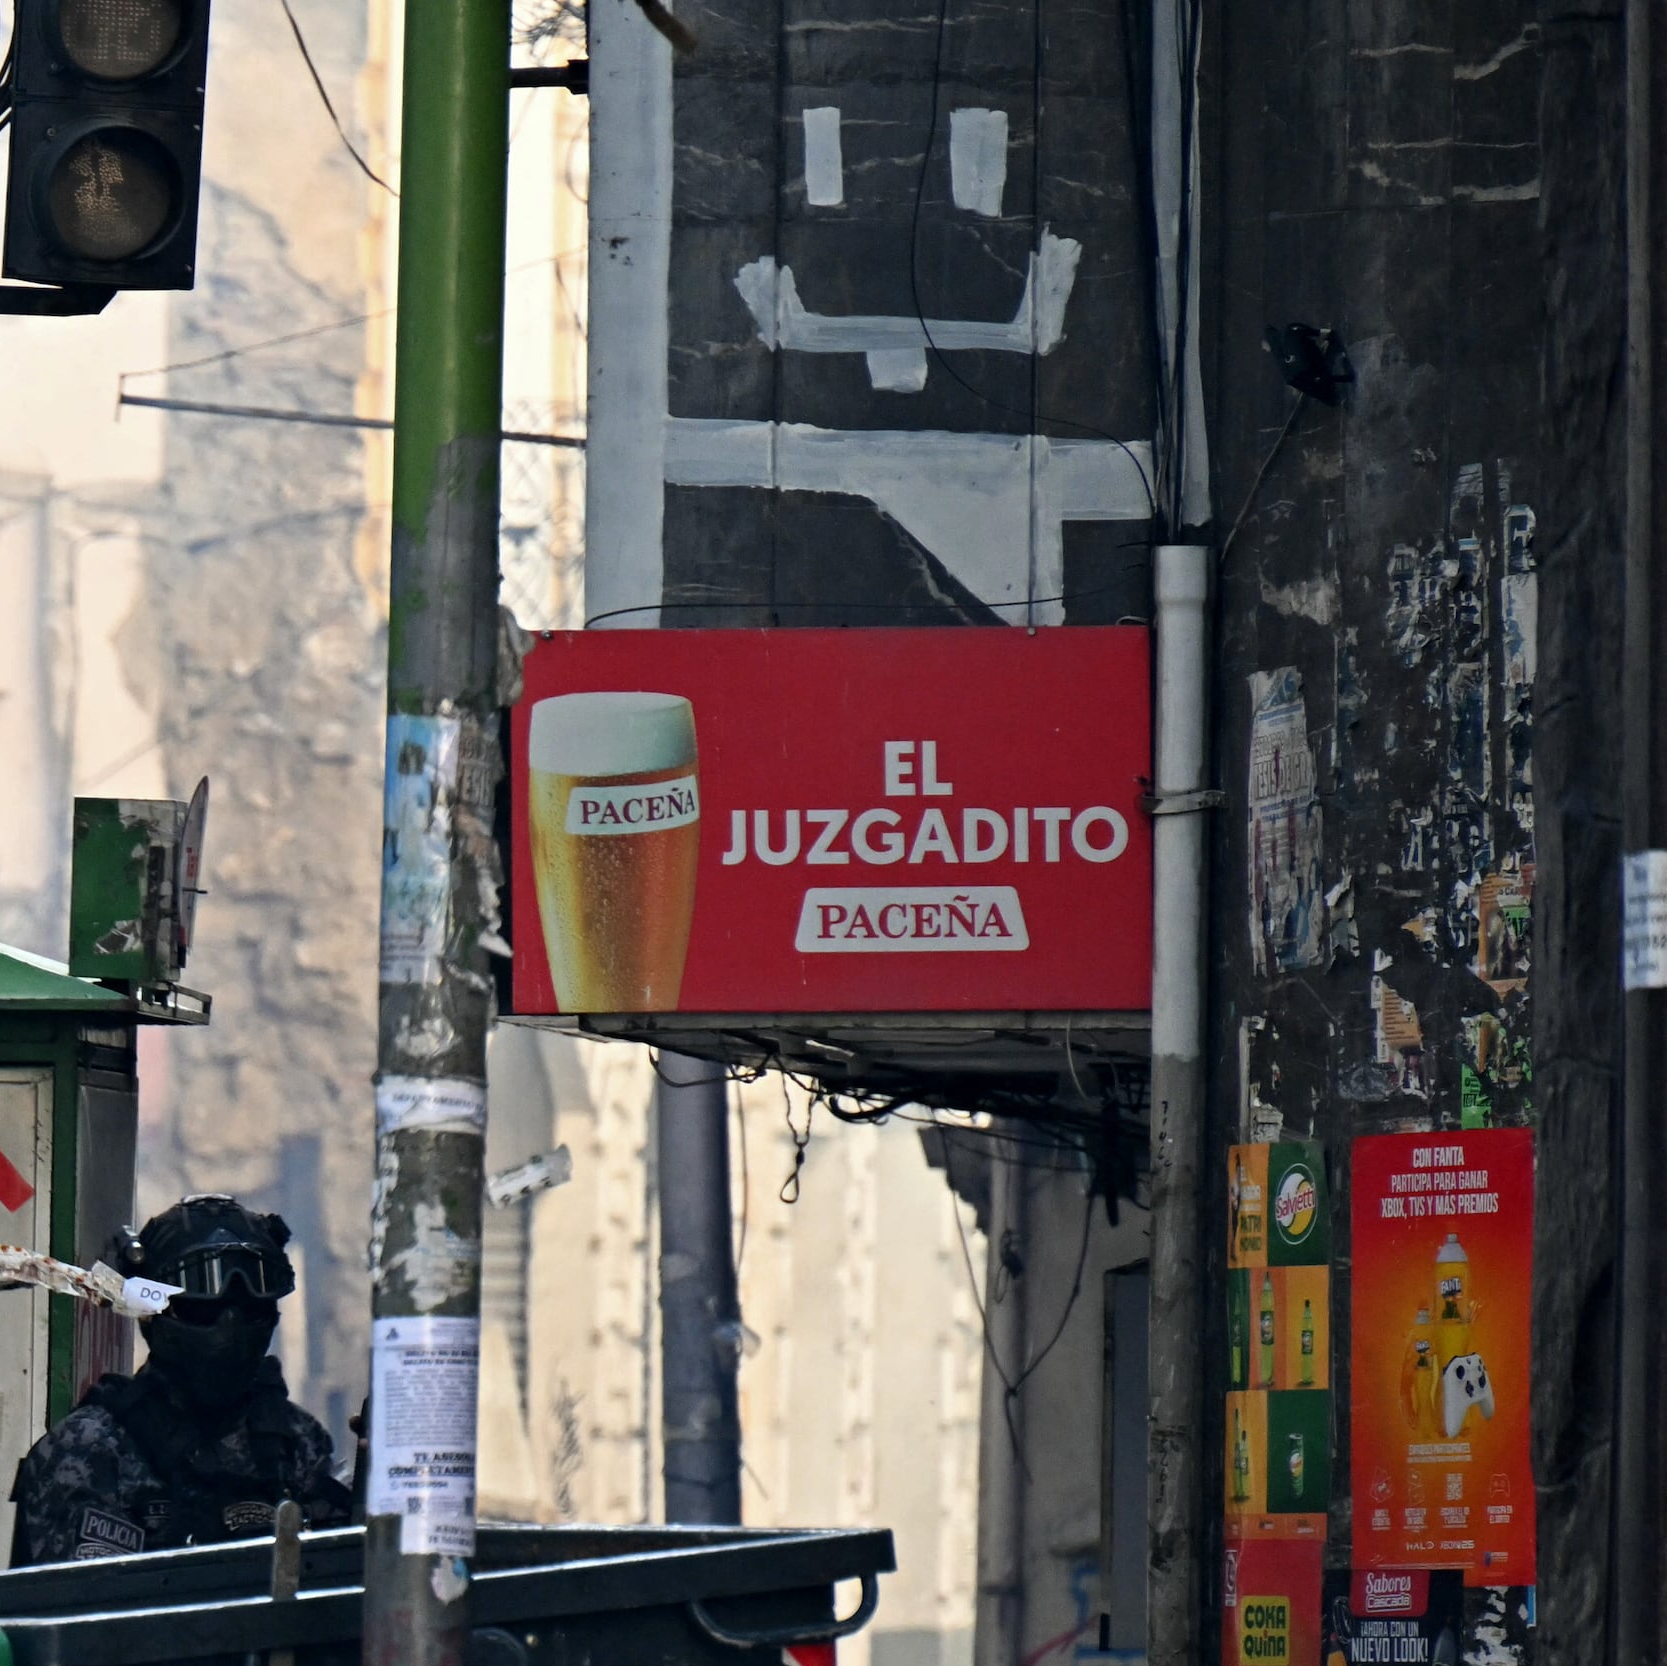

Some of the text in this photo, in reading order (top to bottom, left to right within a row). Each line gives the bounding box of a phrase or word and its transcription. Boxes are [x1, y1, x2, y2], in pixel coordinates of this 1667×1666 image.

[884, 741, 953, 796] EL
[579, 786, 697, 827] PACEÑA
[722, 806, 1128, 866] JUZGADITO
[817, 895, 1011, 939] PACEÑA
[1413, 1146, 1465, 1168] CON FANTA
[1391, 1169, 1488, 1193] PARTICIPA PARA GANAR
[1381, 1197, 1407, 1220] XBOX,
[1427, 1195, 1434, 1216] Y
[1435, 1191, 1456, 1215] MÁS
[1458, 1192, 1499, 1214] PREMIOS
[87, 1515, 138, 1550] POLICIA
[1366, 1572, 1412, 1595] Sabores
[1245, 1605, 1286, 1629] COKA
[1360, 1621, 1420, 1637] ¡AHORA CON UN
[1351, 1637, 1428, 1662] NUEVO LOOK!
